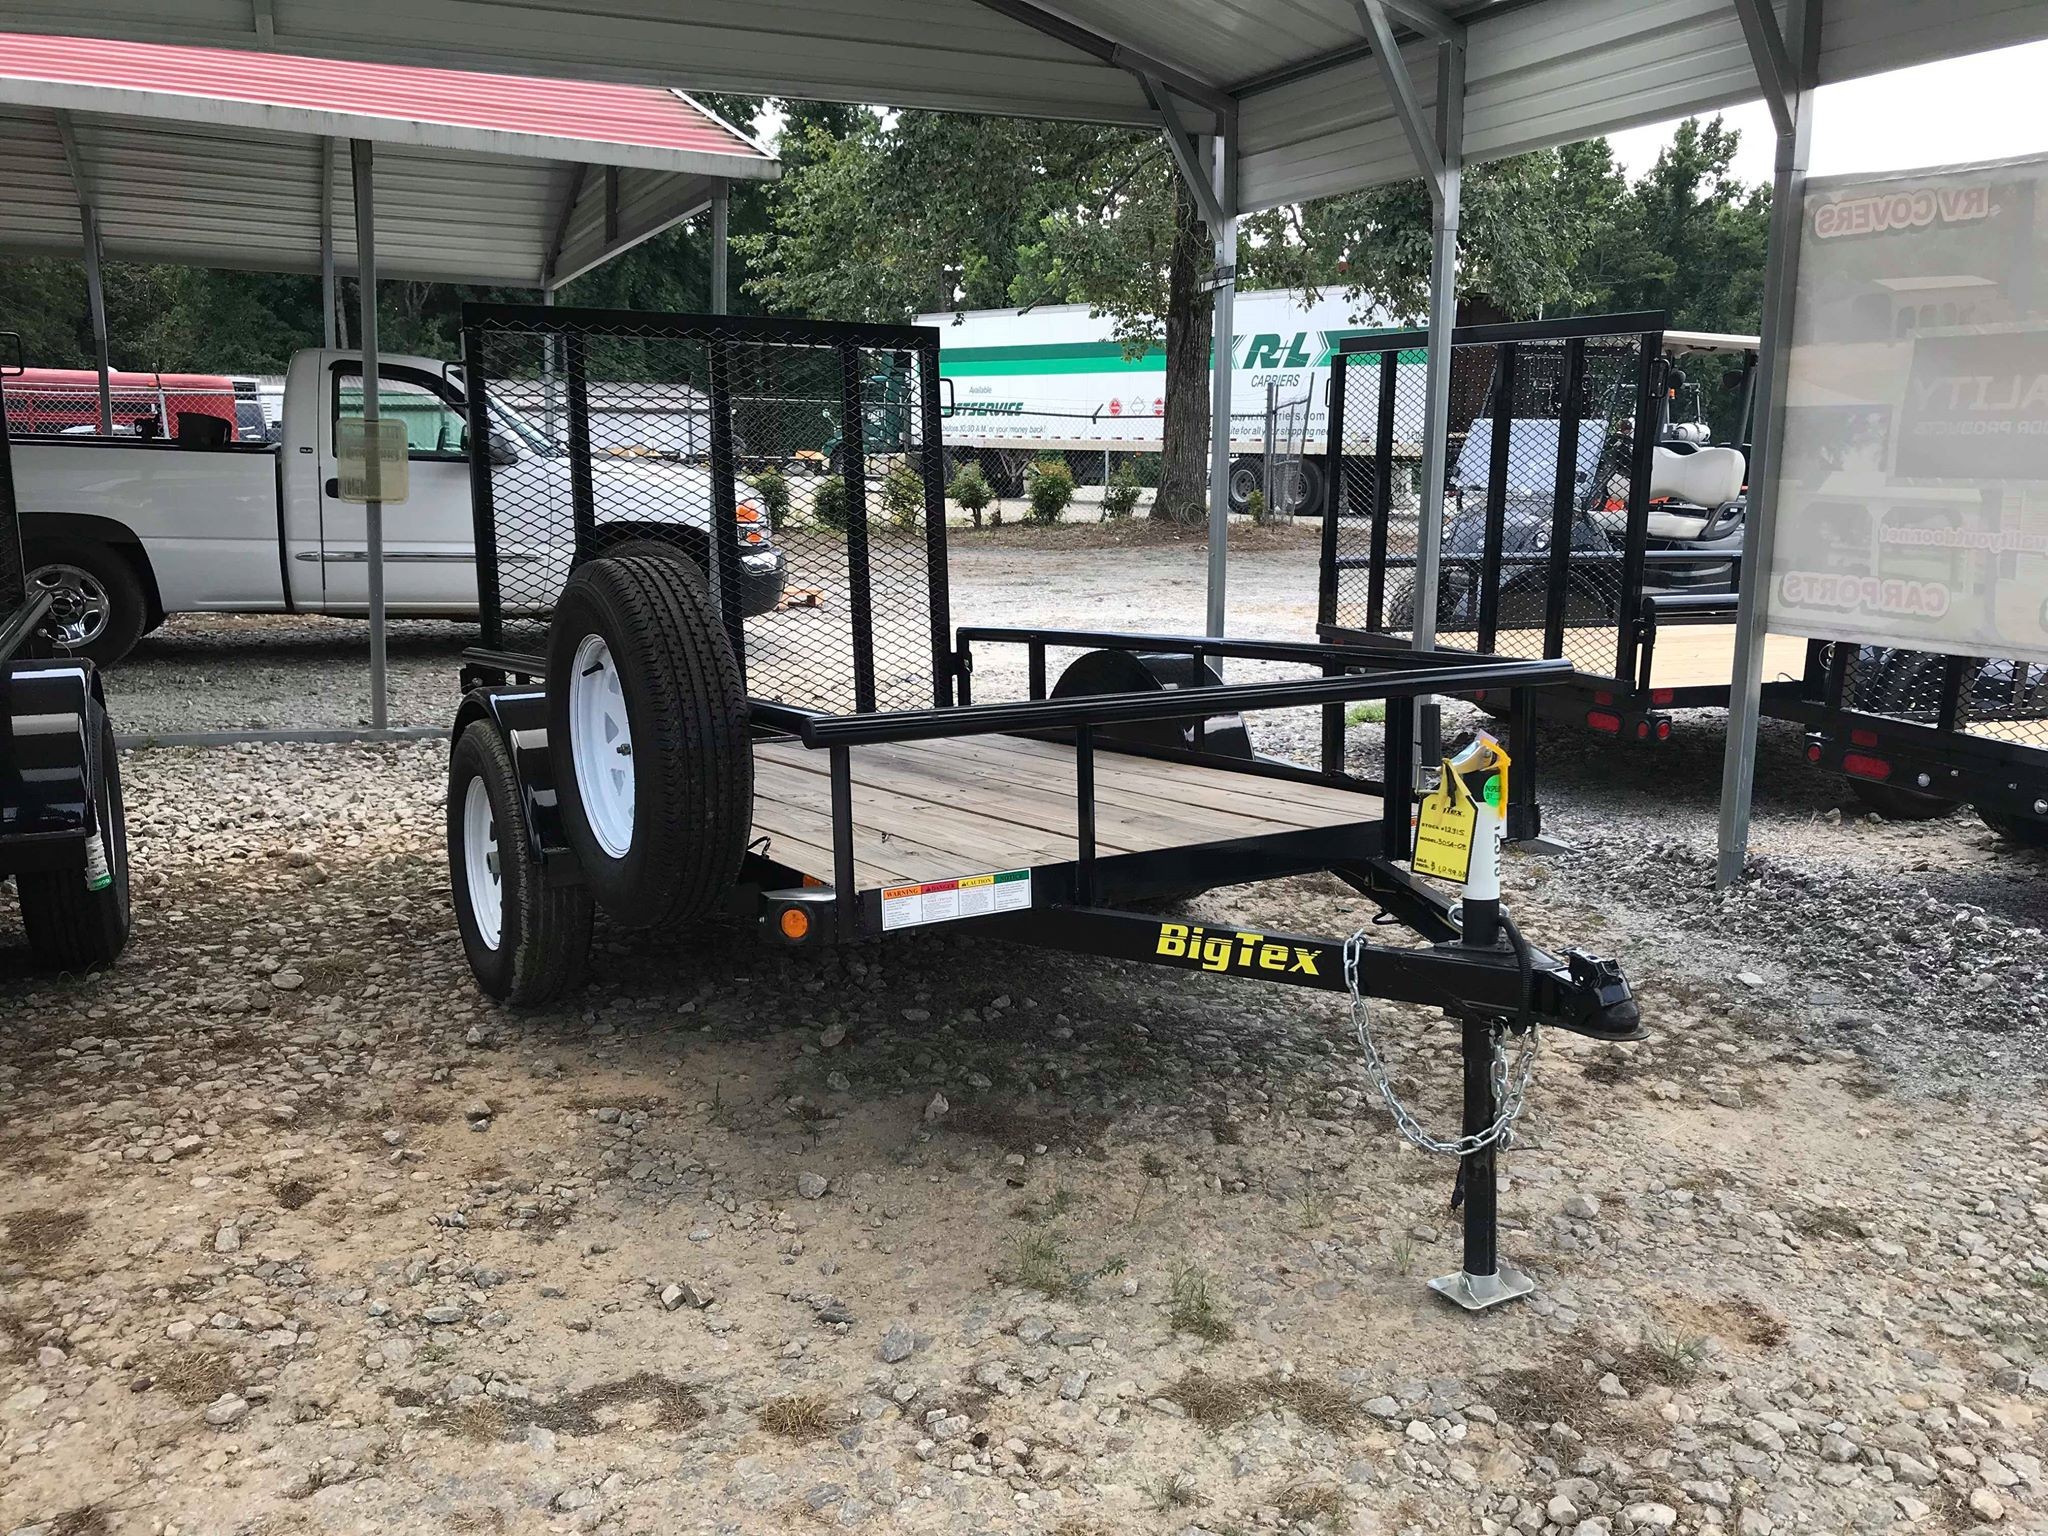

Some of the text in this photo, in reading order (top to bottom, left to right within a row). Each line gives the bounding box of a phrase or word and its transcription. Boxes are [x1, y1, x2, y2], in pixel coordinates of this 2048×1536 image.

[1251, 374, 1300, 387] CARRIERS
[1240, 426, 1251, 435] for
[1252, 427, 1261, 435] all
[966, 877, 992, 887] CAUTION
[886, 888, 919, 899] WARNING
[1156, 922, 1323, 976] BigTex
